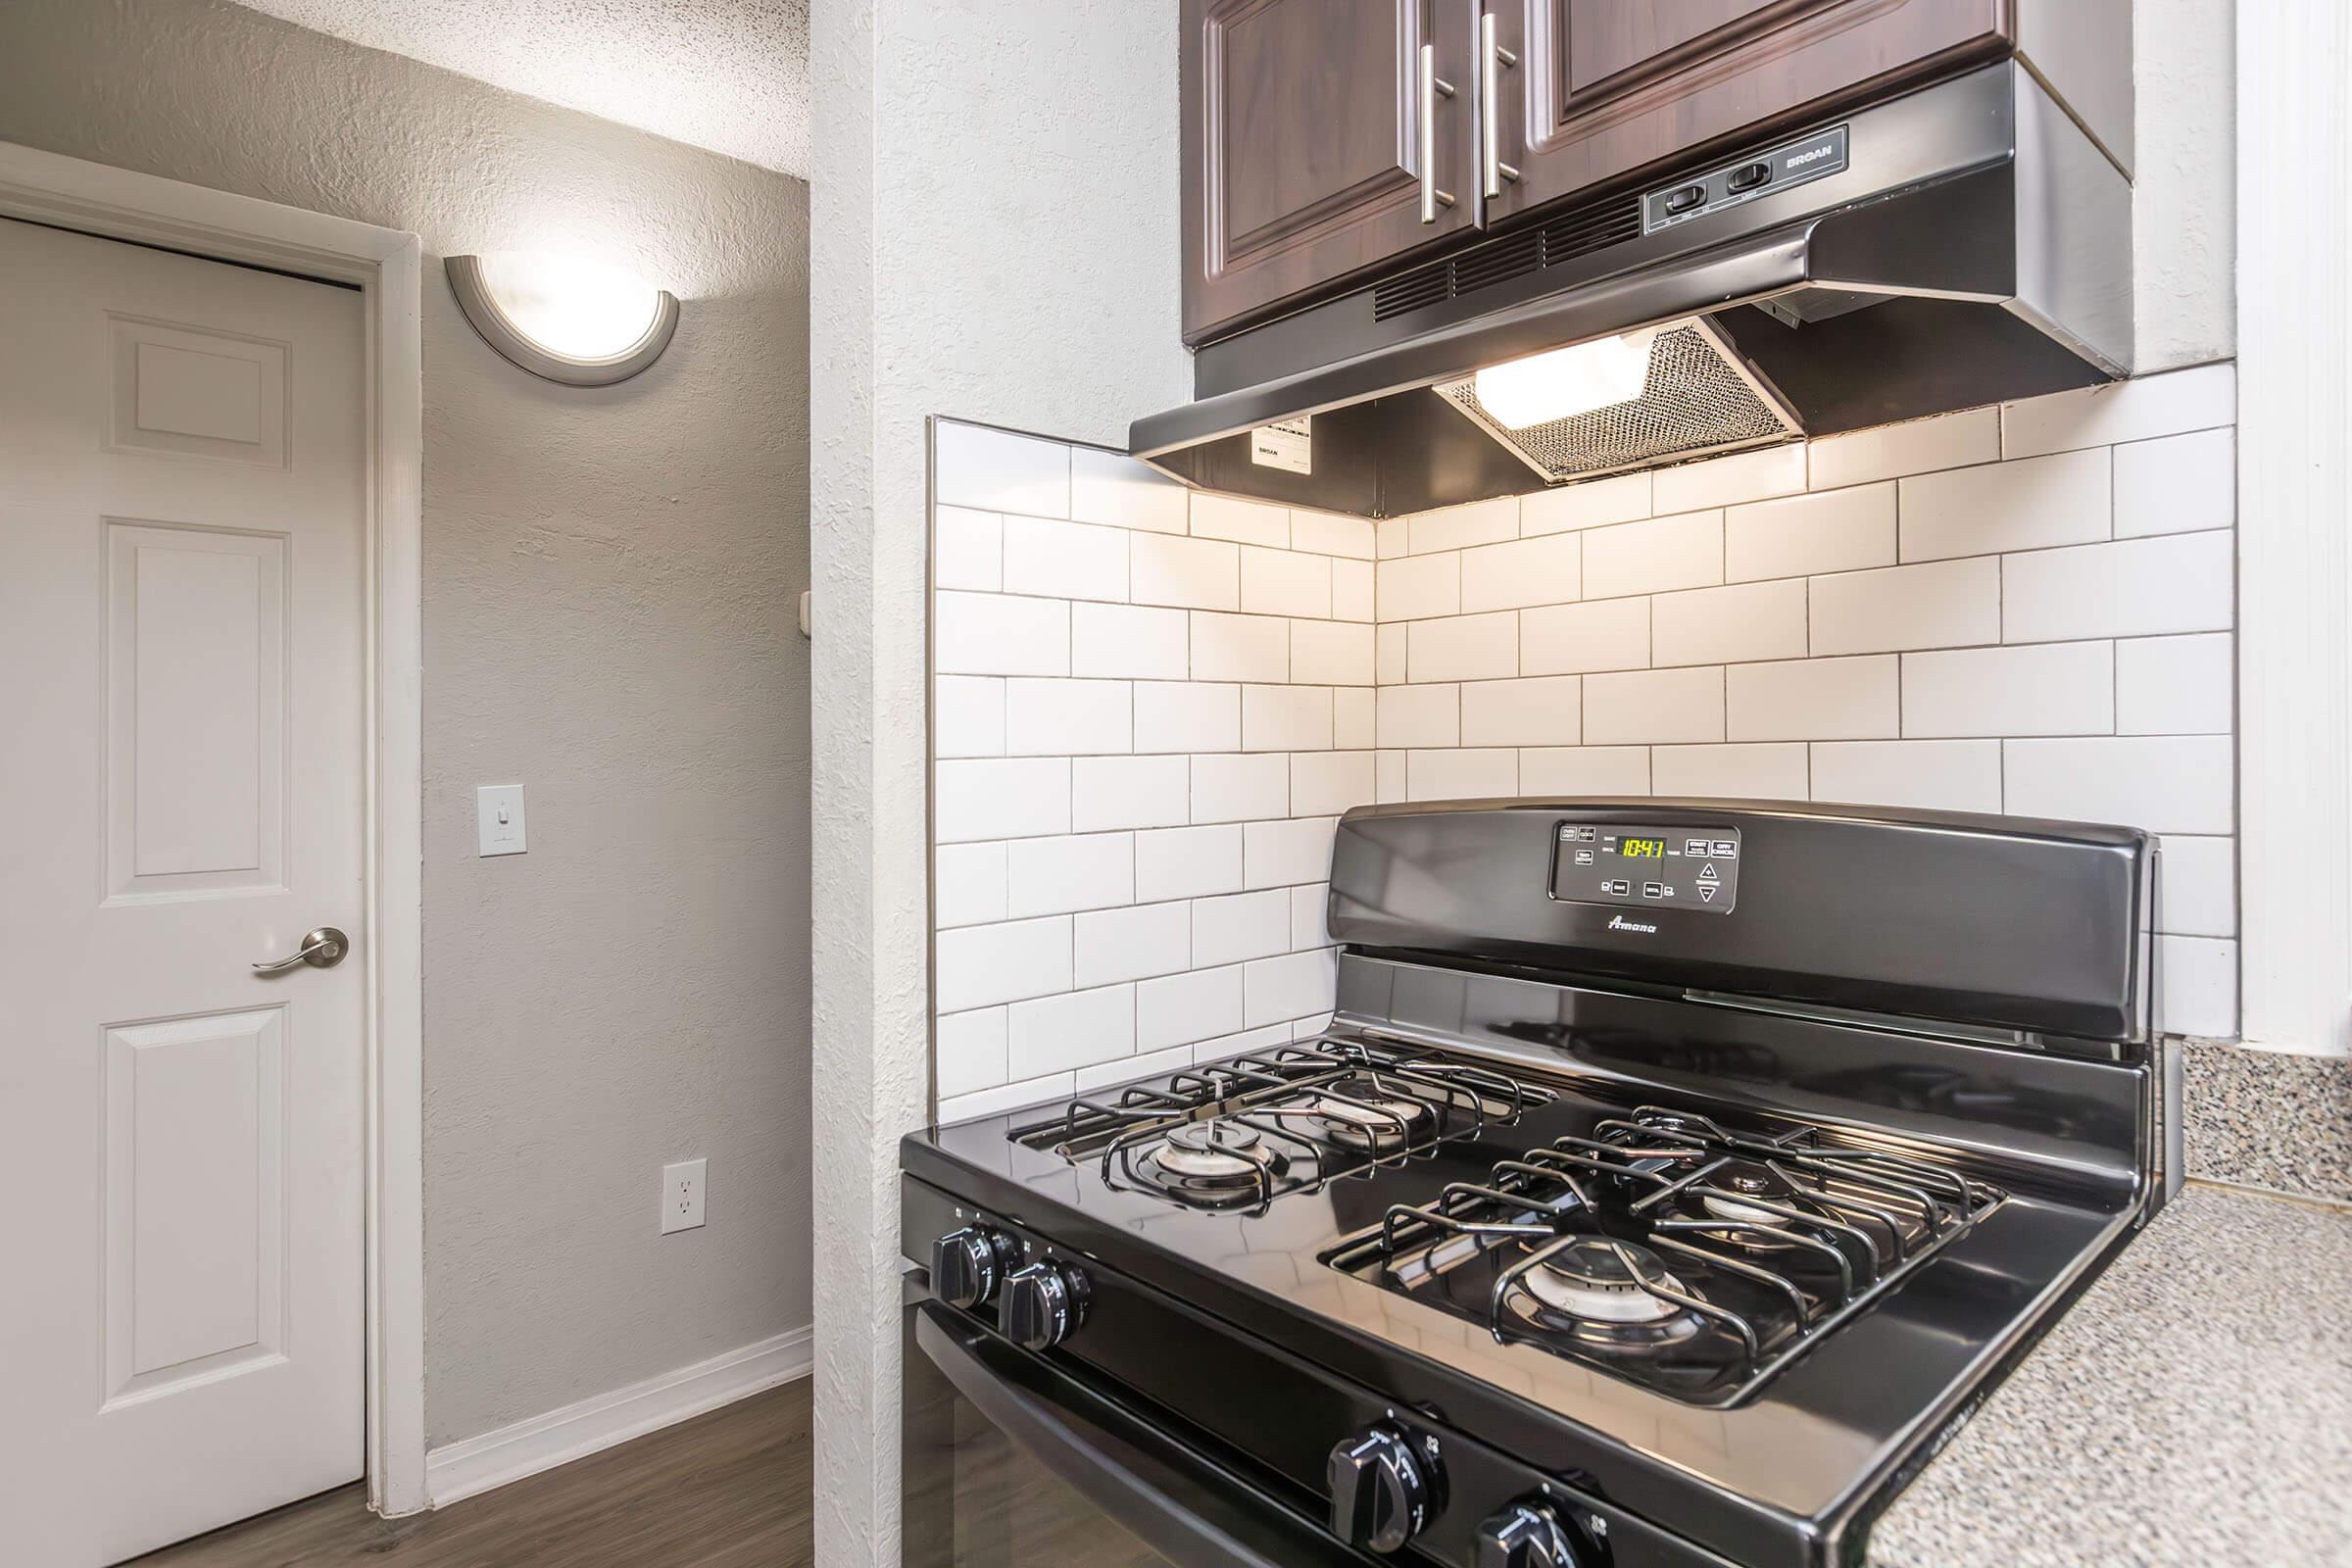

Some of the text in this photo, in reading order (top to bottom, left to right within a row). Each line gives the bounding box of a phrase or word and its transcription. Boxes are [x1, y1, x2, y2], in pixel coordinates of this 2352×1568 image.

[1787, 145, 1833, 169] BROAN
[1623, 839, 1663, 858] 10:41
[1608, 915, 1657, 933] Amana
